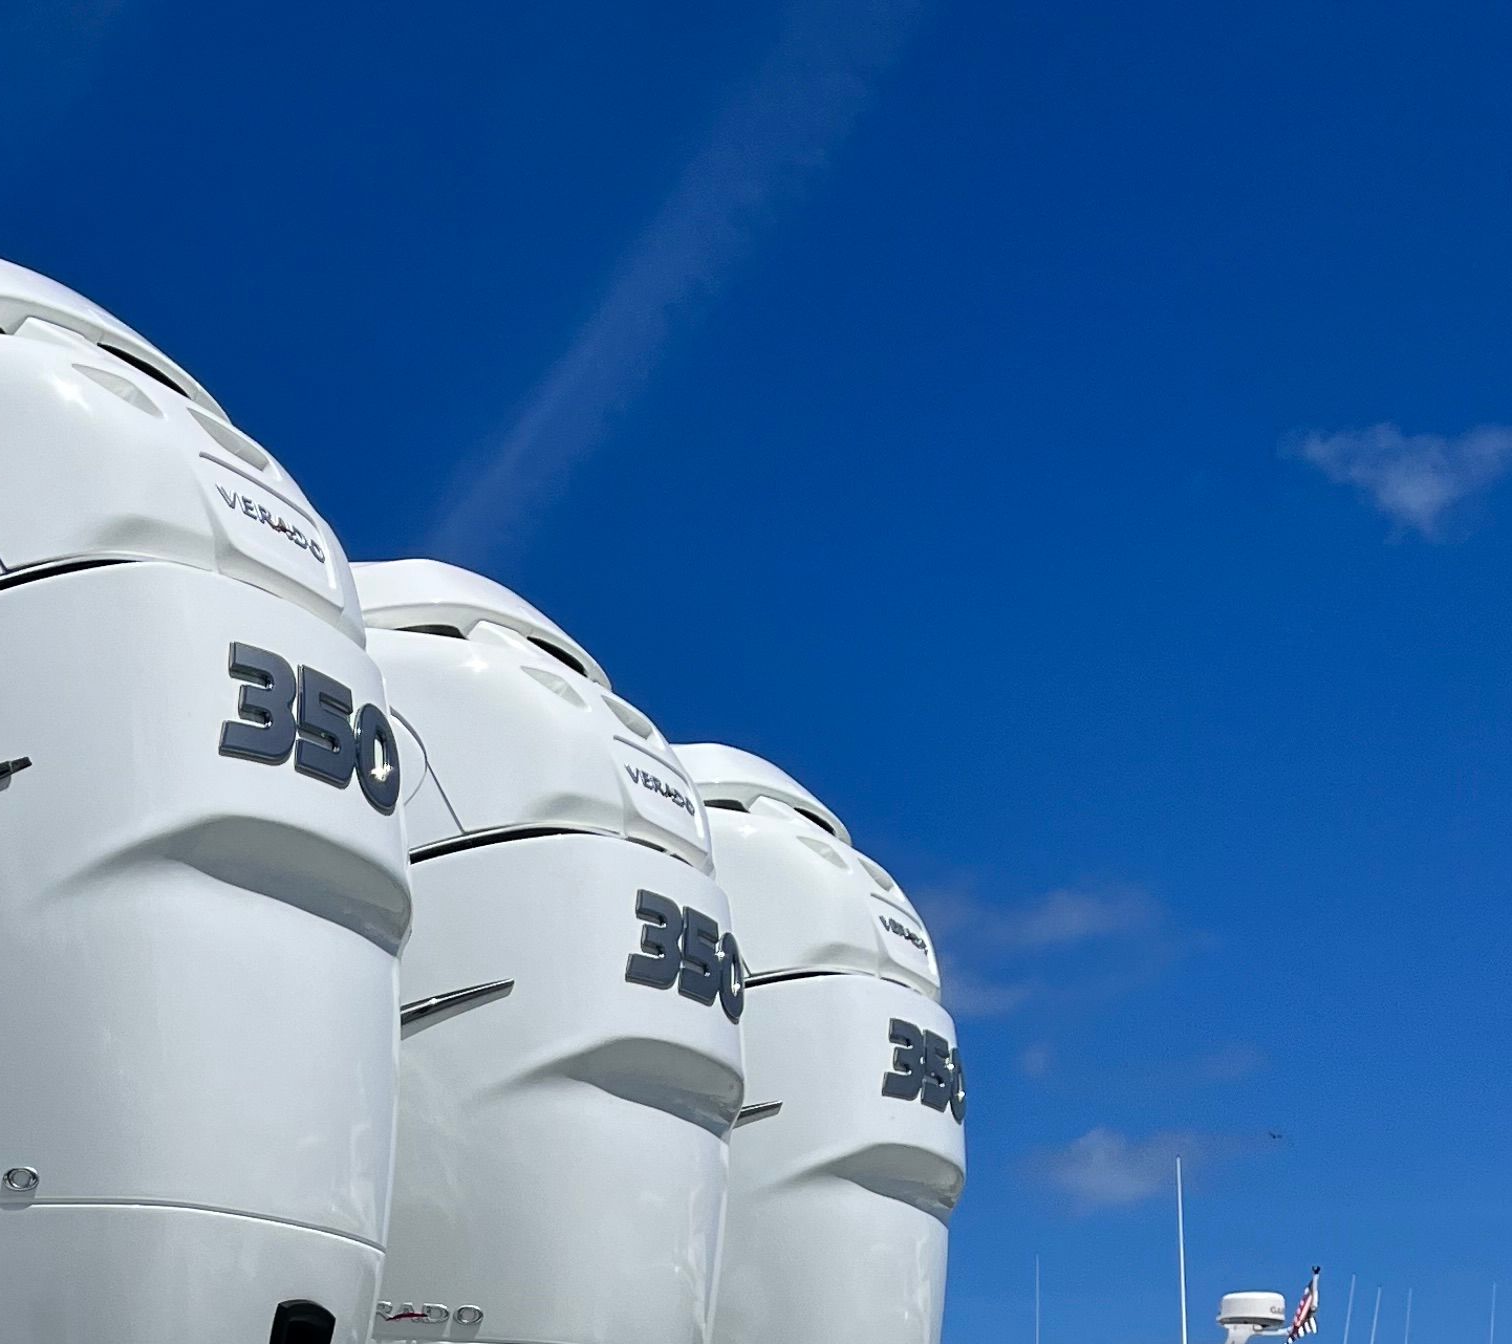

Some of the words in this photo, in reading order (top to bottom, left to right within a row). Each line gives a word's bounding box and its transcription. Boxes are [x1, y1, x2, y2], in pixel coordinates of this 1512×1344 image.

[216, 482, 326, 564] VERADO
[218, 641, 401, 816] 350
[624, 763, 695, 816] VERADO
[624, 888, 745, 1025] 350
[881, 1017, 967, 1125] 350
[375, 1300, 484, 1325] RADO
